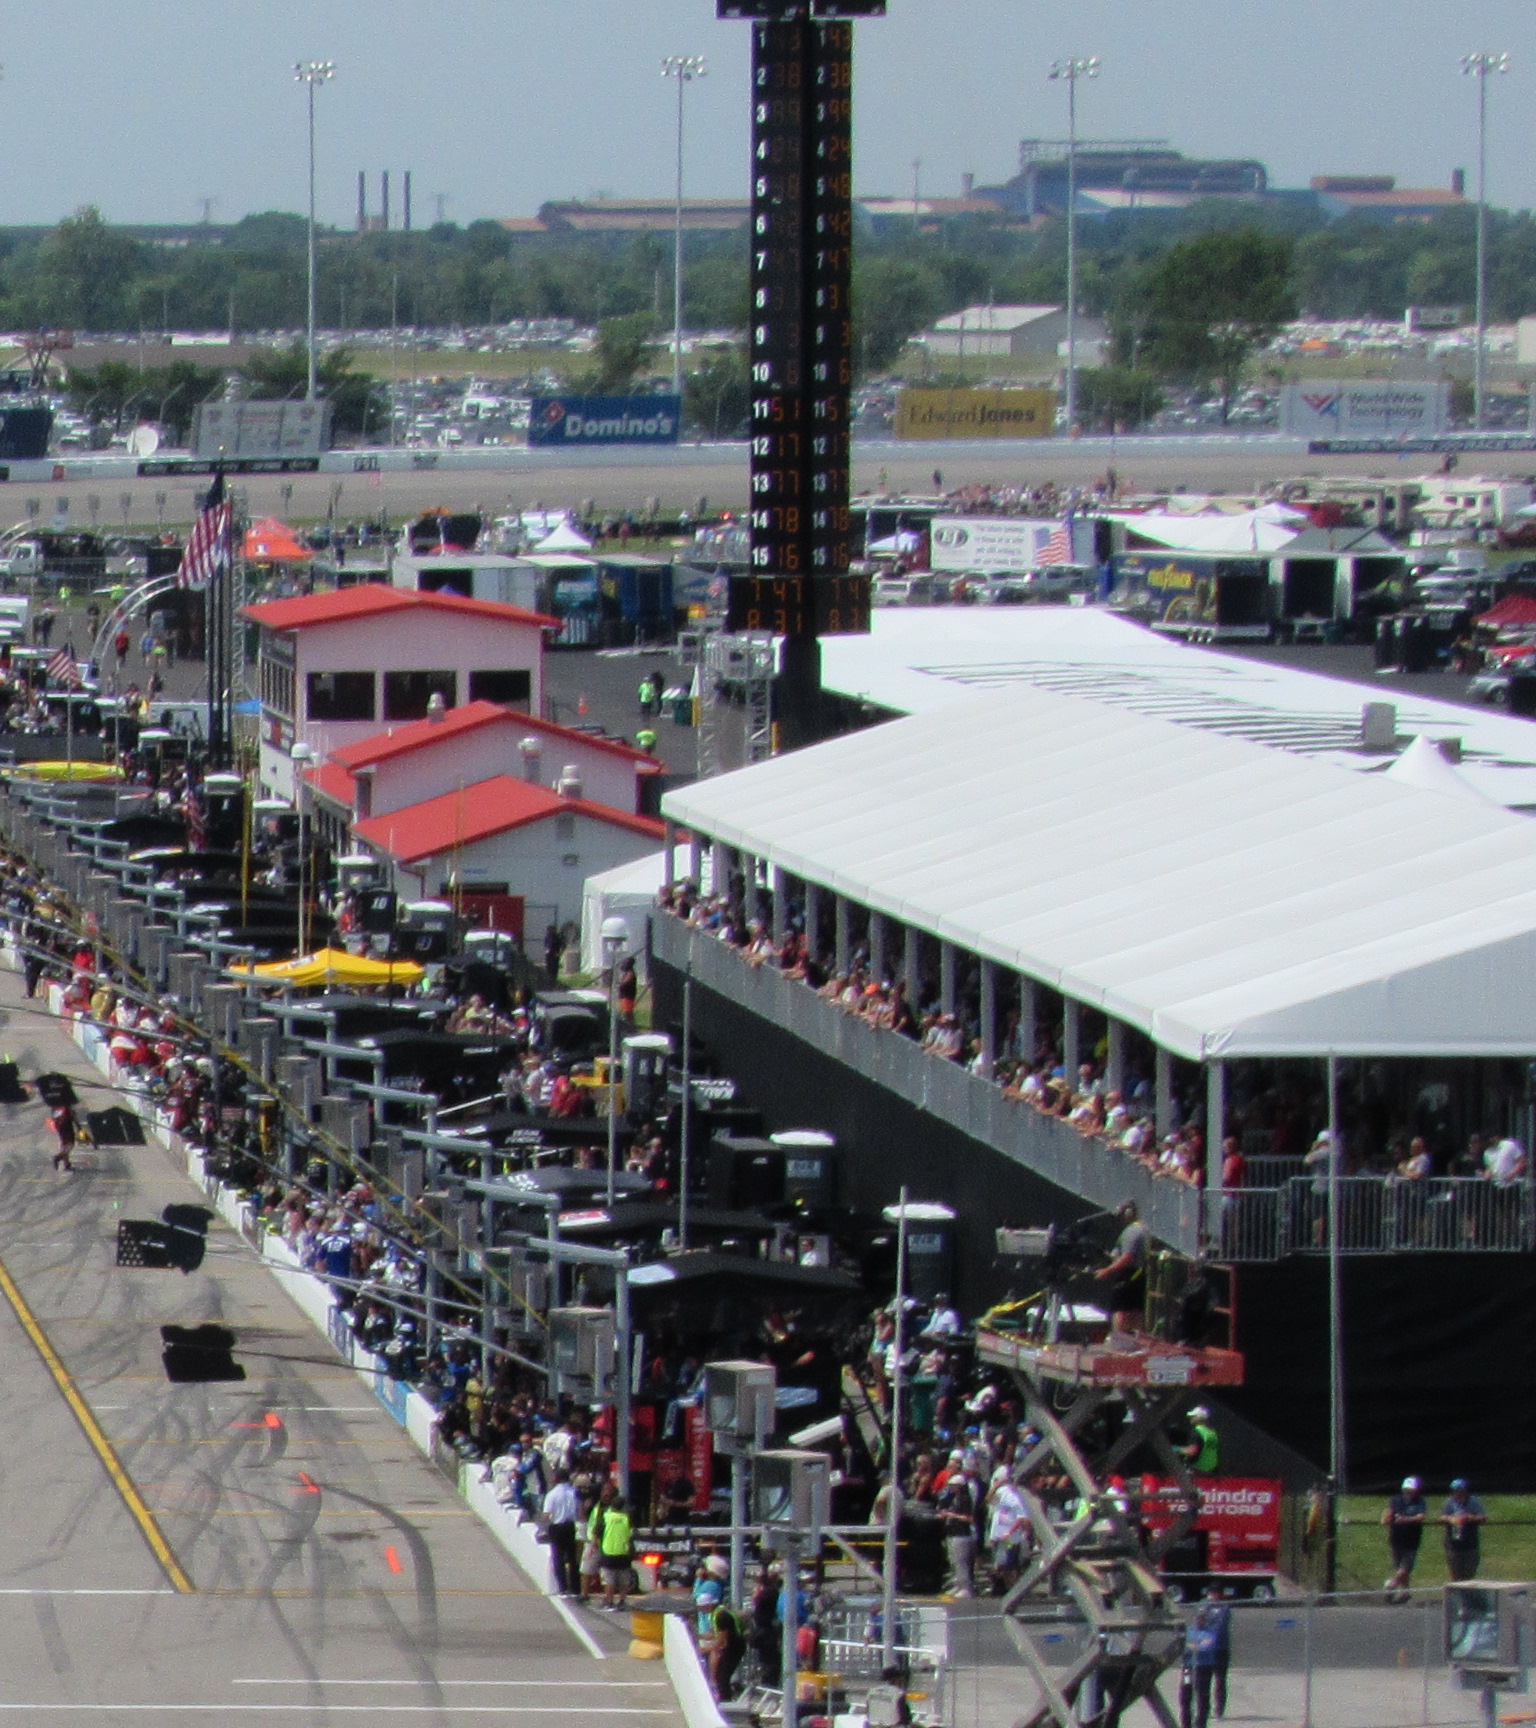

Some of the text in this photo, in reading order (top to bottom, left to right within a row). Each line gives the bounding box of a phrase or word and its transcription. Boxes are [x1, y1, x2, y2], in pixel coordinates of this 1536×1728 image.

[759, 30, 766, 48] 1
[756, 66, 767, 86] 2
[756, 103, 766, 124] 3
[756, 140, 767, 160] 4
[756, 177, 766, 197] 5
[756, 215, 766, 235] 6
[756, 251, 766, 271] 7
[756, 288, 766, 309] 8
[756, 325, 765, 346] 9
[752, 362, 770, 382] 10
[752, 400, 768, 418] 11
[565, 411, 673, 437] Domino's
[752, 437, 769, 455] 12
[753, 474, 769, 492] 13
[752, 510, 768, 528] 14
[752, 547, 769, 566] 15
